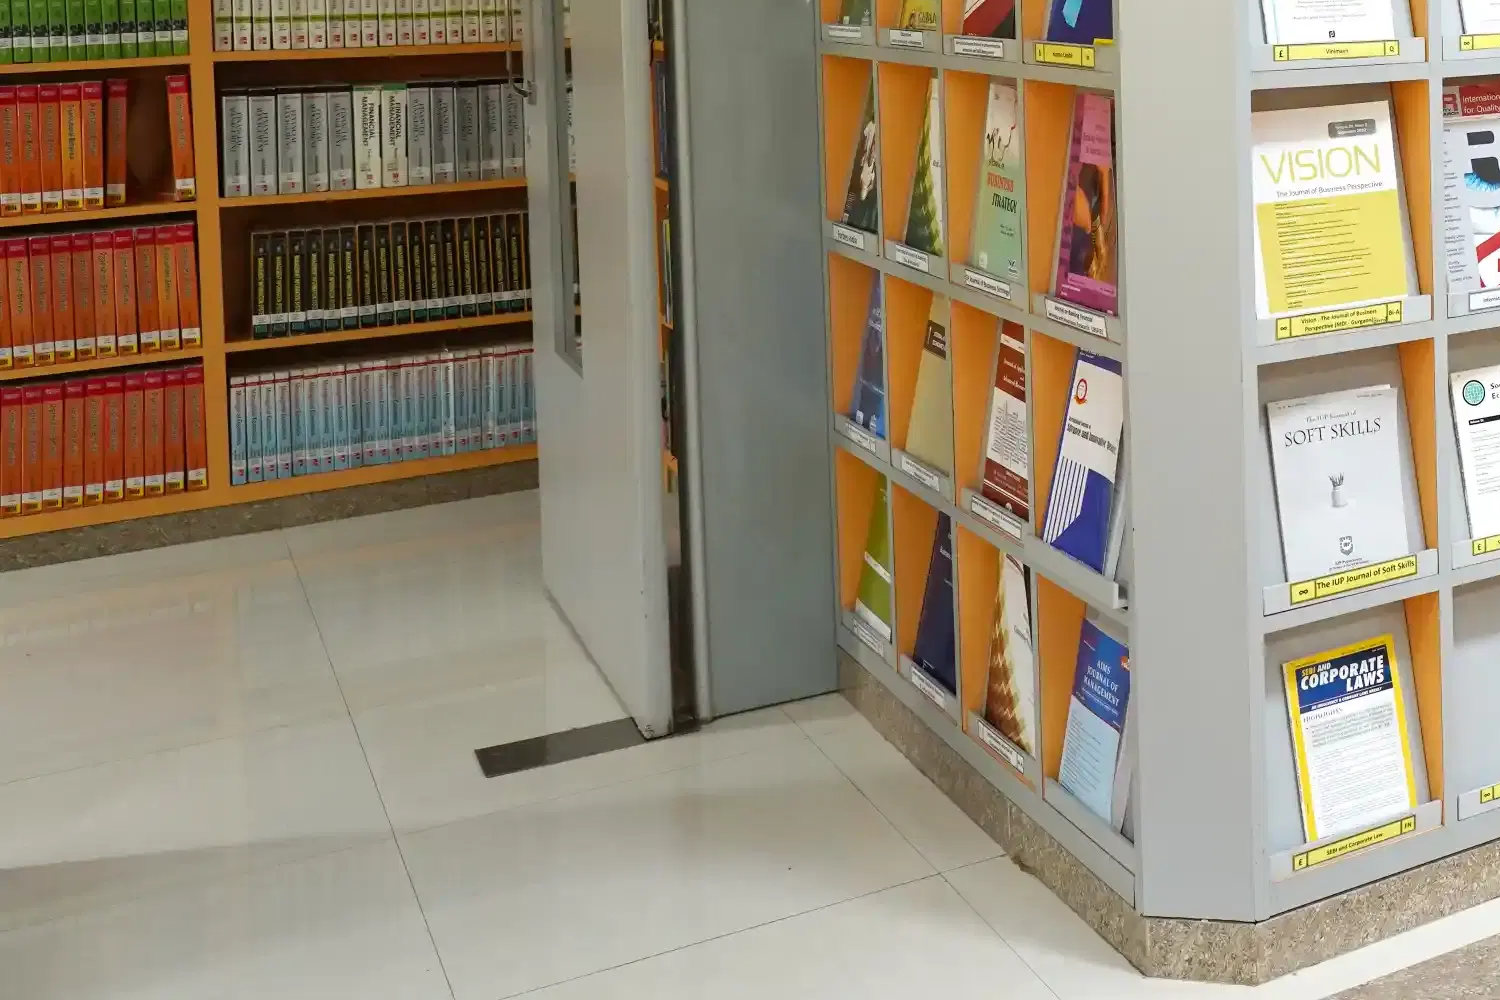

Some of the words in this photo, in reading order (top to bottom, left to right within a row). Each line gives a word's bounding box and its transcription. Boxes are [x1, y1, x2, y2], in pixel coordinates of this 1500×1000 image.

[1464, 106, 1474, 114] for
[1476, 104, 1500, 114] Quality
[1260, 144, 1380, 184] VISION
[1276, 190, 1288, 198] The
[1289, 188, 1310, 198] Journal
[1310, 186, 1318, 195] of
[1318, 185, 1346, 194] Business
[1347, 181, 1383, 192] Perspective
[992, 193, 1017, 214] STRATEGY
[1302, 316, 1316, 324] Vision
[1330, 313, 1350, 321] Journal
[1356, 309, 1377, 318] Business
[1284, 426, 1326, 448] SOFT
[1331, 418, 1380, 440] SKILLS
[1317, 582, 1330, 590] The
[1332, 577, 1344, 586] IUP
[1346, 572, 1372, 584] Journal
[1373, 568, 1380, 577] of
[1382, 564, 1396, 574] Soft
[1398, 560, 1414, 571] Skills
[1087, 666, 1110, 688] JOURNAL
[1110, 682, 1120, 692] OF
[1097, 660, 1111, 674] AIMS
[1084, 675, 1120, 706] MANAGEMENT
[1346, 669, 1384, 693] LAWS
[1326, 848, 1338, 856] SEBI
[1348, 836, 1372, 849] Corporate
[1374, 832, 1383, 840] Law
